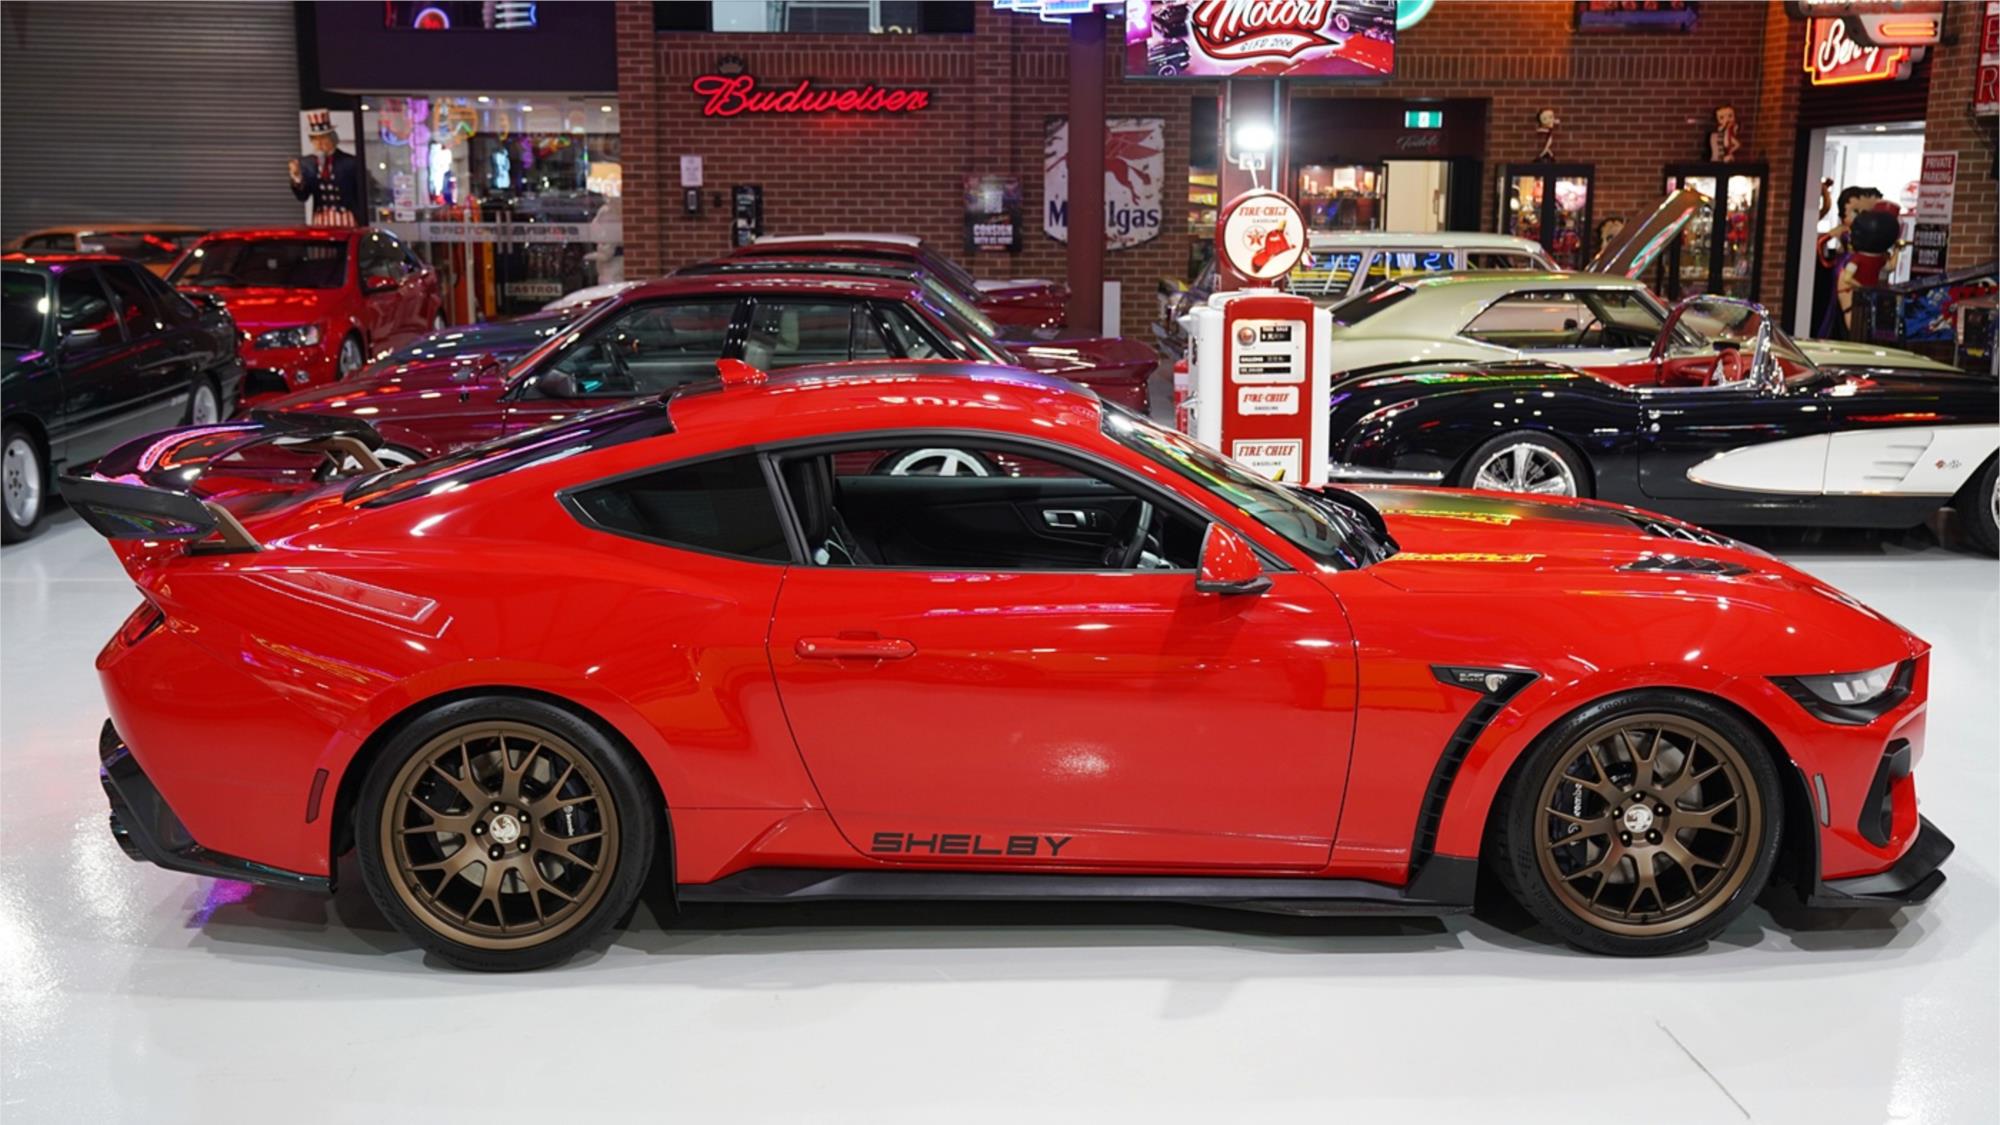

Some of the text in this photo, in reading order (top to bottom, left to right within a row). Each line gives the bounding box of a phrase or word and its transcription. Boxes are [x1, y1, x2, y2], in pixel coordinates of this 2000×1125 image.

[1200, 1, 1326, 41] Motors
[692, 75, 929, 116] Budweiser
[1048, 200, 1160, 235] Mlgas
[1243, 393, 1290, 403] FIRE-CHIEF
[1238, 445, 1296, 456] FIRE-CHIEF
[871, 832, 1072, 856] SHELBY
